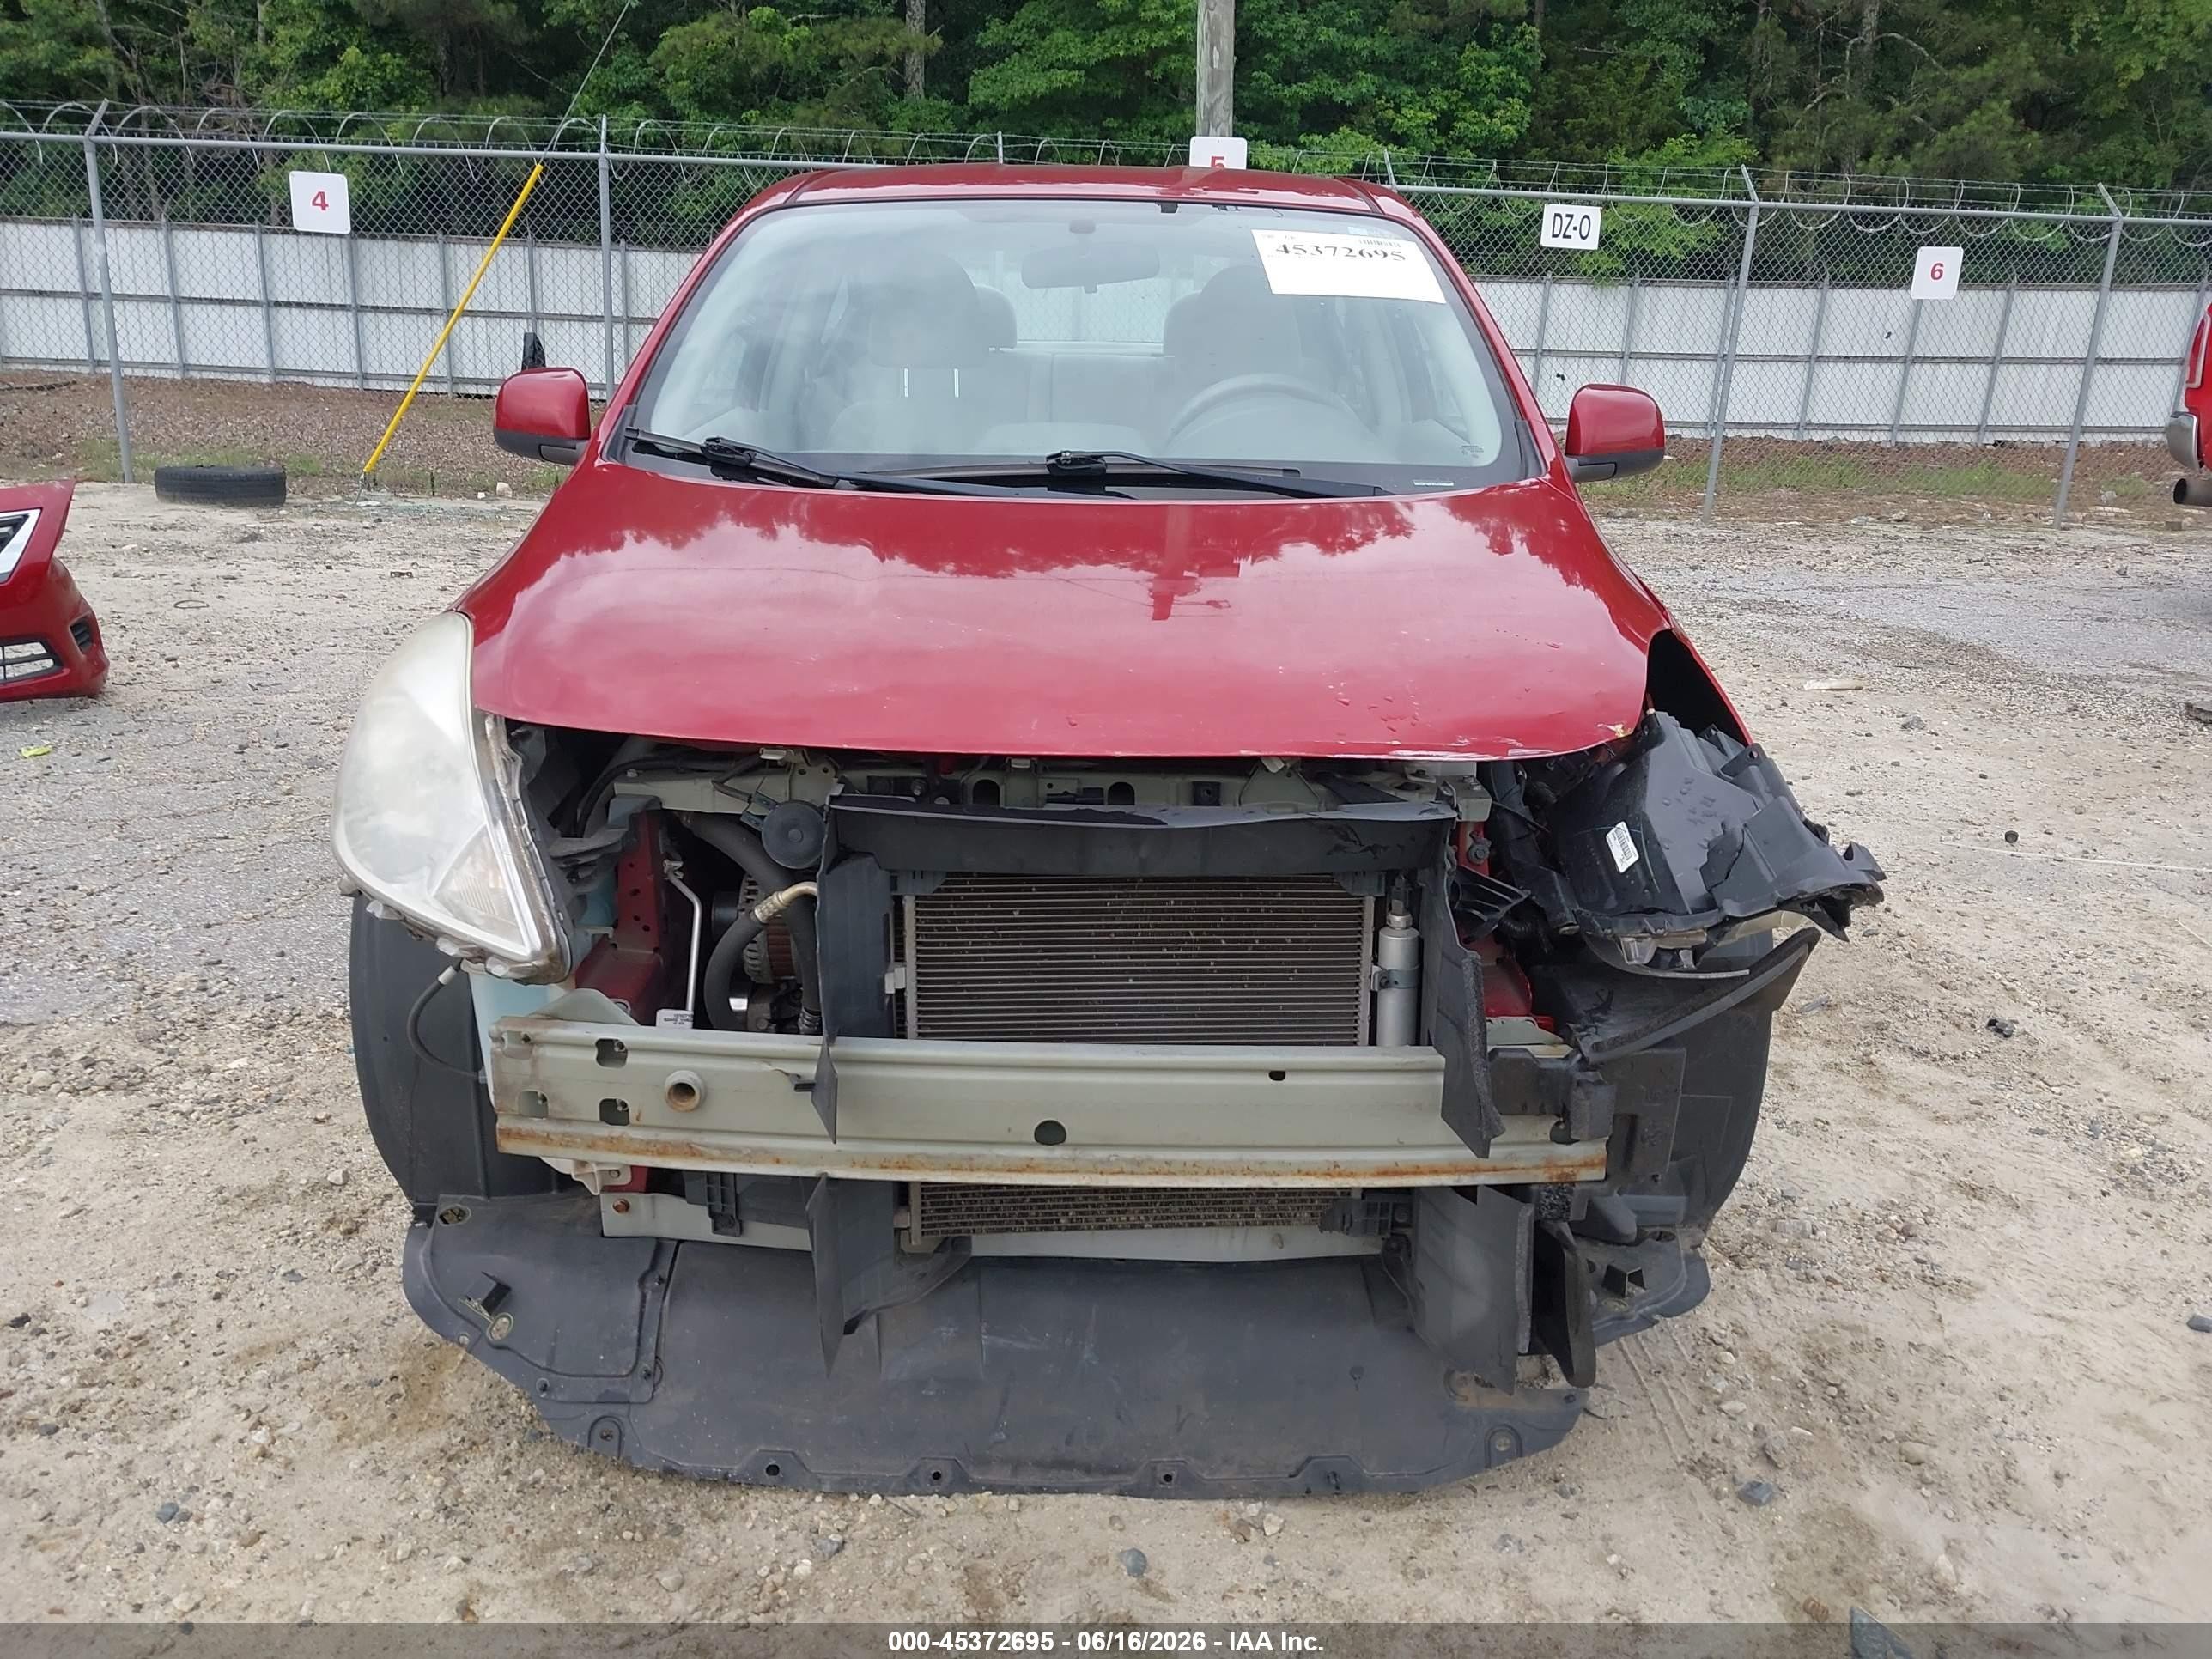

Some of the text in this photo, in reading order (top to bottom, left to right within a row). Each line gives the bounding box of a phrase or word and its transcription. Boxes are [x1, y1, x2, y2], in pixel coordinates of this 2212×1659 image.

[312, 191, 329, 211] 4
[1275, 243, 1406, 262] 45372695
[1930, 262, 1944, 281] 6
